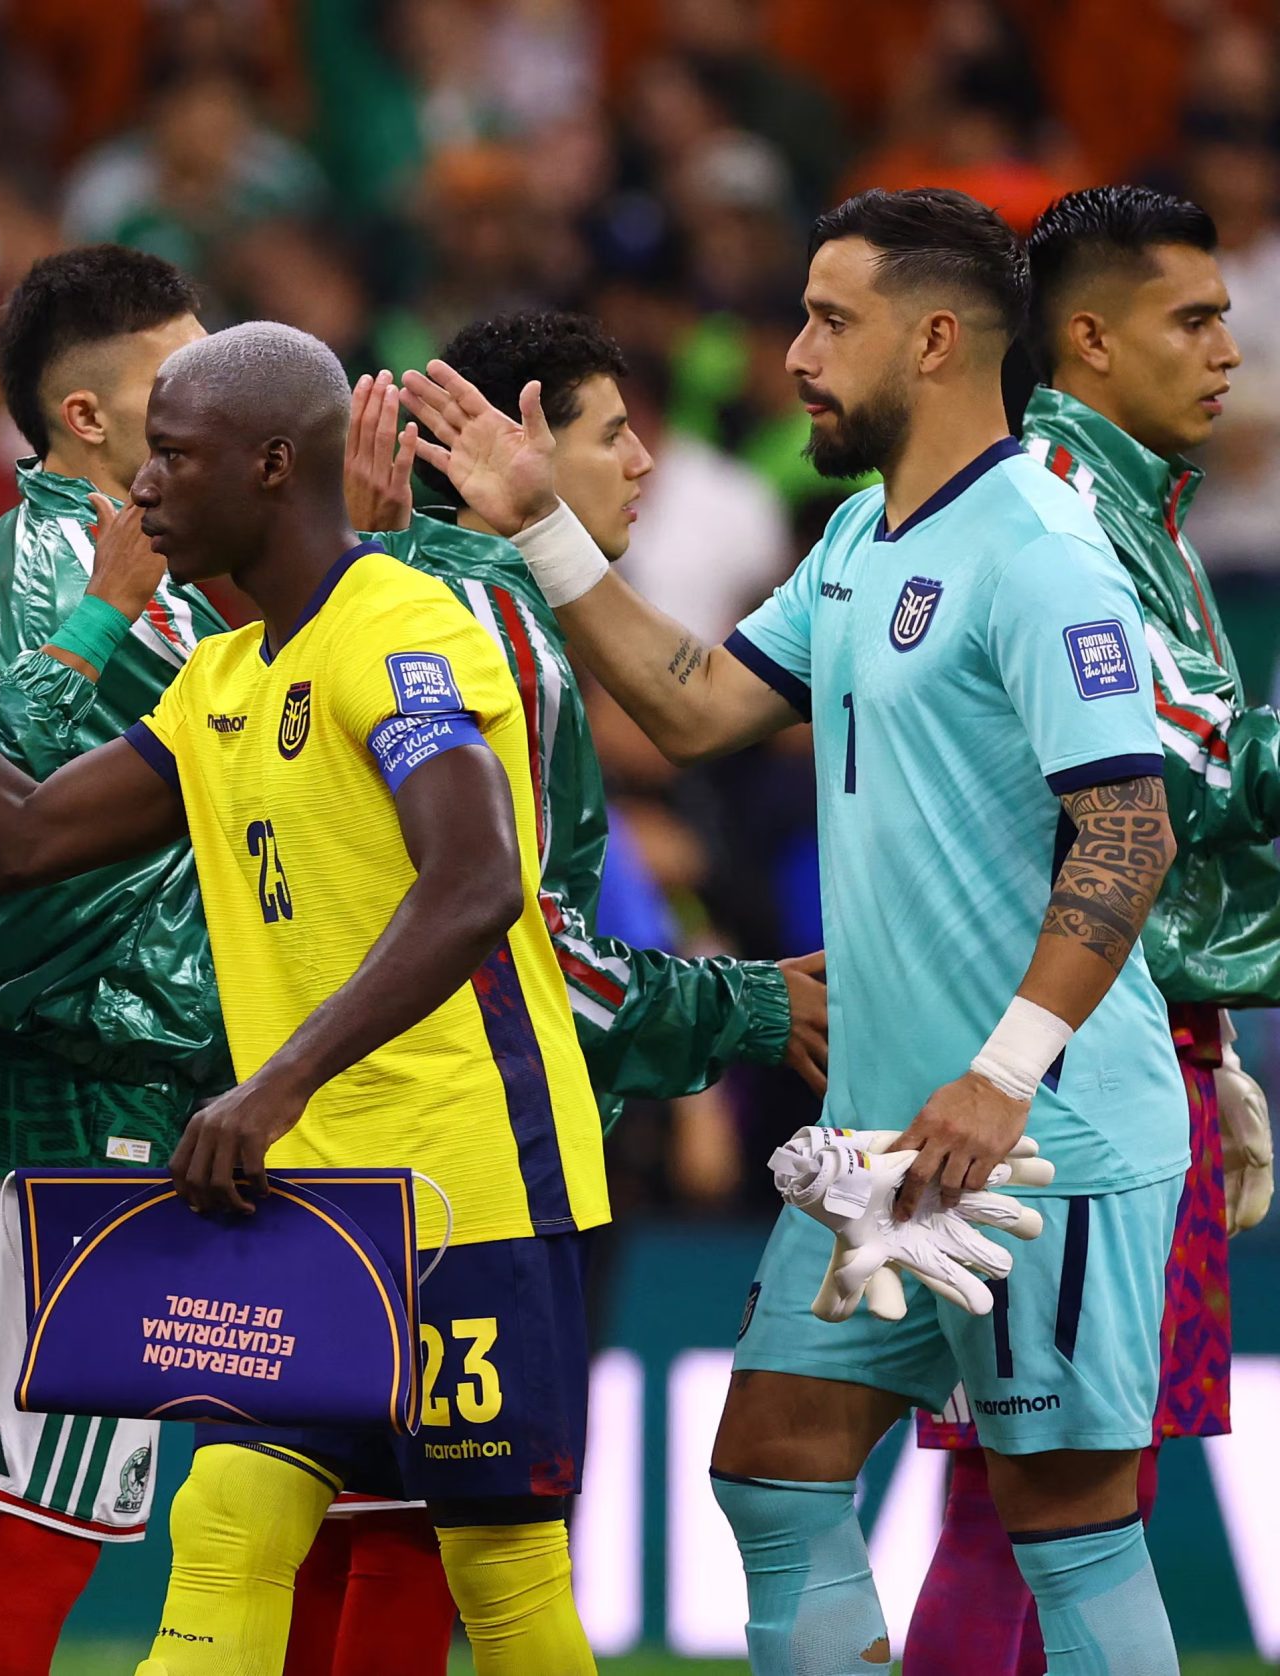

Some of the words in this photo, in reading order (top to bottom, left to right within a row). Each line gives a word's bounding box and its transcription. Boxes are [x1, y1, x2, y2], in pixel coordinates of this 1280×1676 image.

[1077, 632, 1118, 649] FOOTBALL
[1080, 643, 1122, 664] UNITES
[400, 661, 442, 673] FOOTBALL
[1082, 663, 1100, 679] the
[1100, 659, 1127, 675] World
[402, 670, 445, 686] UNITES
[1099, 675, 1118, 685] FIFA
[404, 686, 423, 699] the
[422, 683, 452, 698] World
[420, 696, 440, 704] FIFA
[384, 752, 405, 773] the
[402, 721, 454, 753] World
[842, 692, 857, 794] 1
[408, 745, 437, 765] FIFA
[166, 1295, 250, 1328] FÚTBOL
[251, 1306, 283, 1329] DE
[142, 1317, 296, 1357] ECUATORIANA
[142, 1343, 282, 1381] FEDERACIÓN
[420, 1317, 503, 1426] 23
[974, 1394, 1060, 1415] marathon
[424, 1438, 511, 1460] marathon
